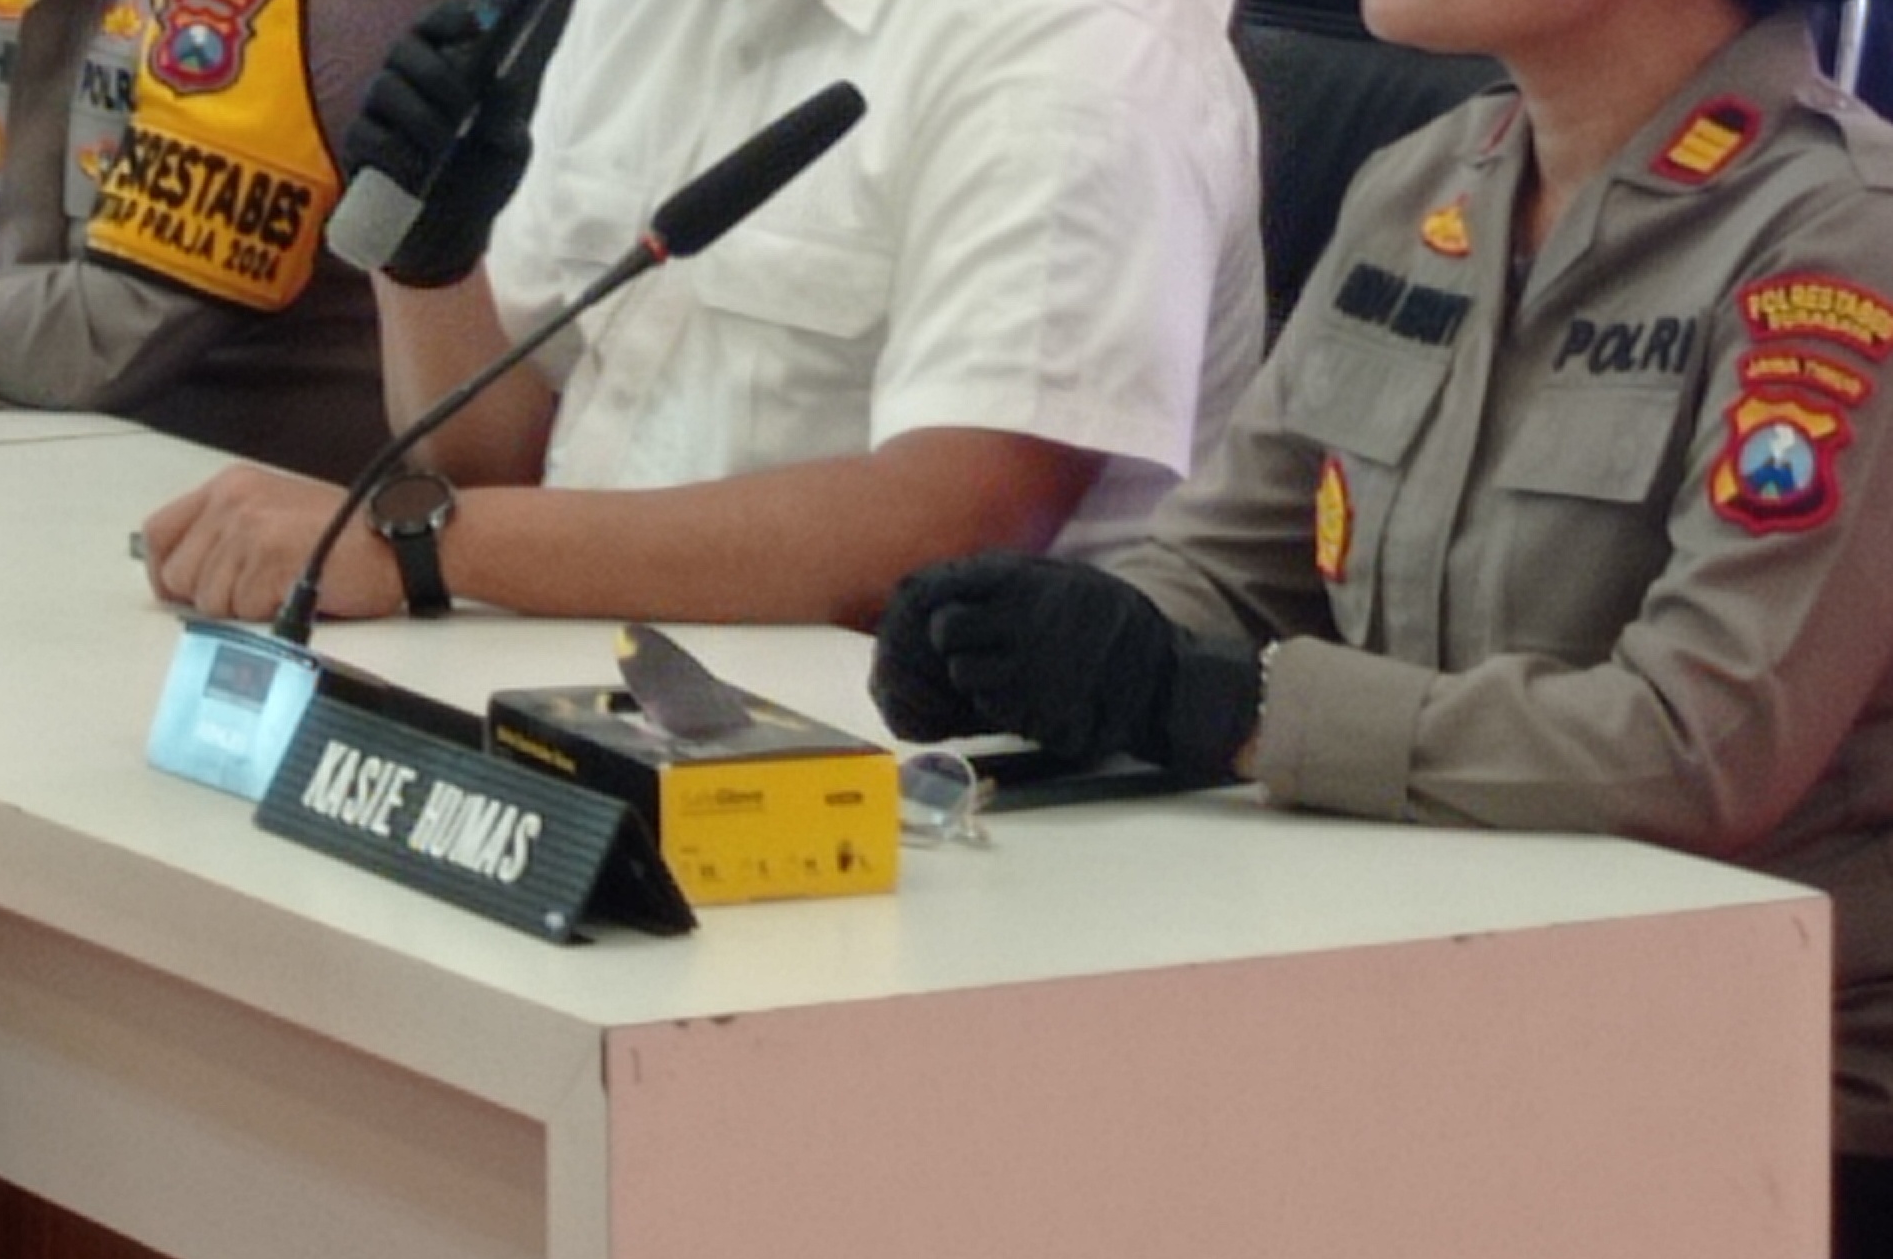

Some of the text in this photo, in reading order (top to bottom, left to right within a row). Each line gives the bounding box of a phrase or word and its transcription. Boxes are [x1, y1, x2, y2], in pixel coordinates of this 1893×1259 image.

[1553, 315, 1696, 376] POLRI
[300, 739, 418, 837] KASIE
[408, 779, 544, 884] HUMAS
